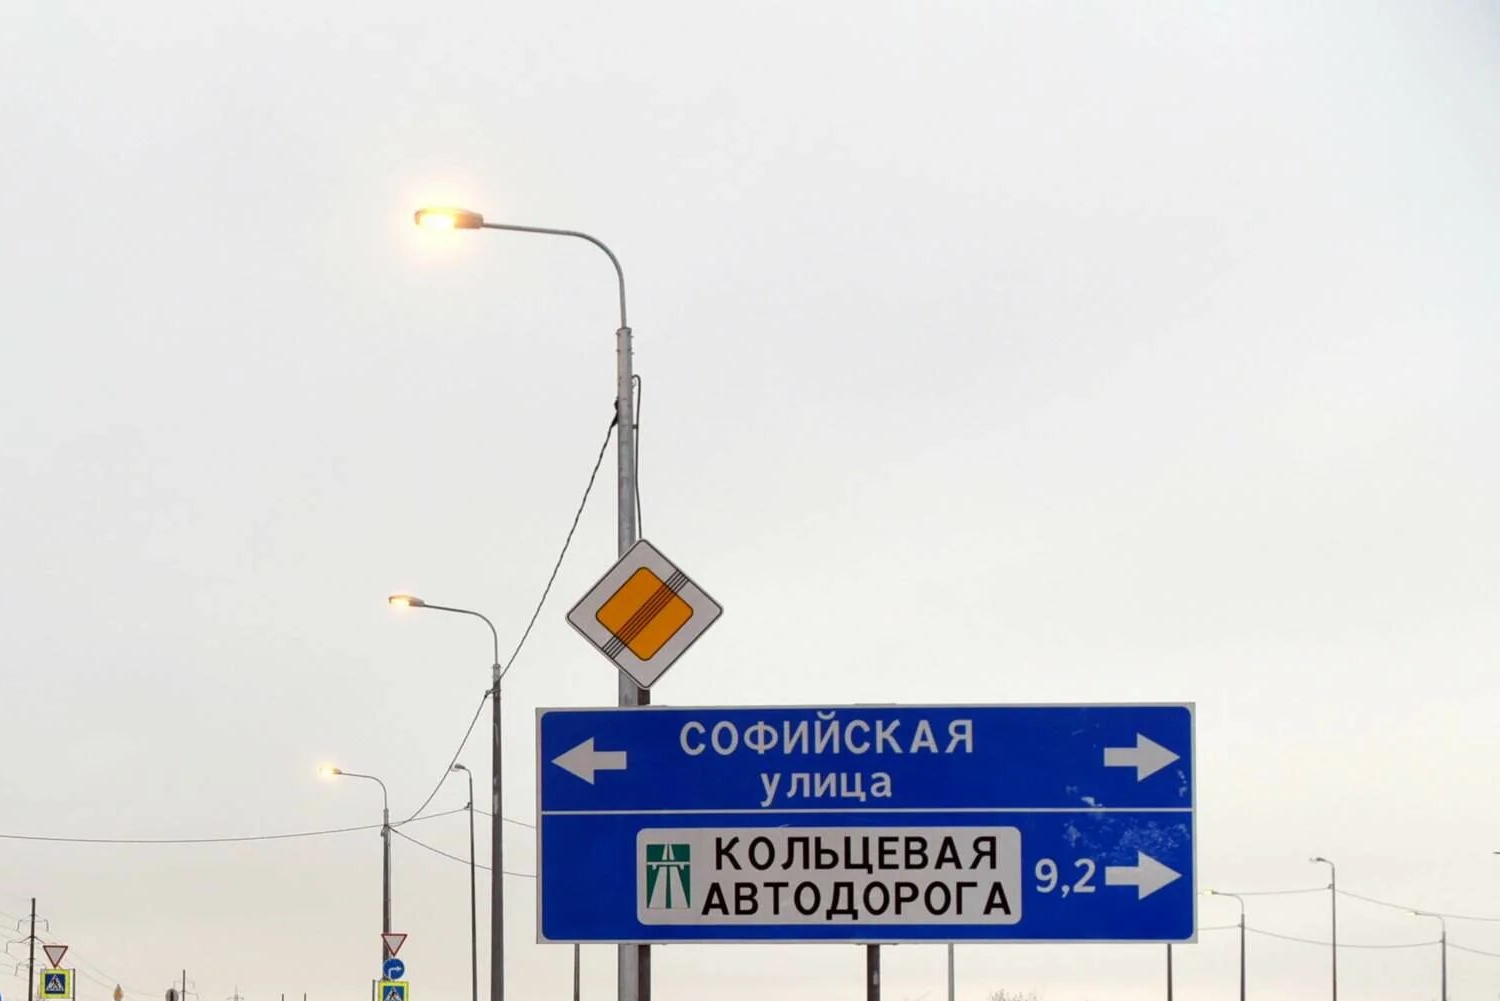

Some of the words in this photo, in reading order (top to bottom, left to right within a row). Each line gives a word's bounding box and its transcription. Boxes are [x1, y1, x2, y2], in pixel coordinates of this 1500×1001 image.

[680, 710, 974, 756] СОФИЙСКАЯ
[760, 769, 892, 806] улица
[715, 836, 997, 875] КОЛЬЦЕВАЯ
[1034, 858, 1097, 899] 9,2
[701, 881, 1011, 920] АВТОДОРОГА
